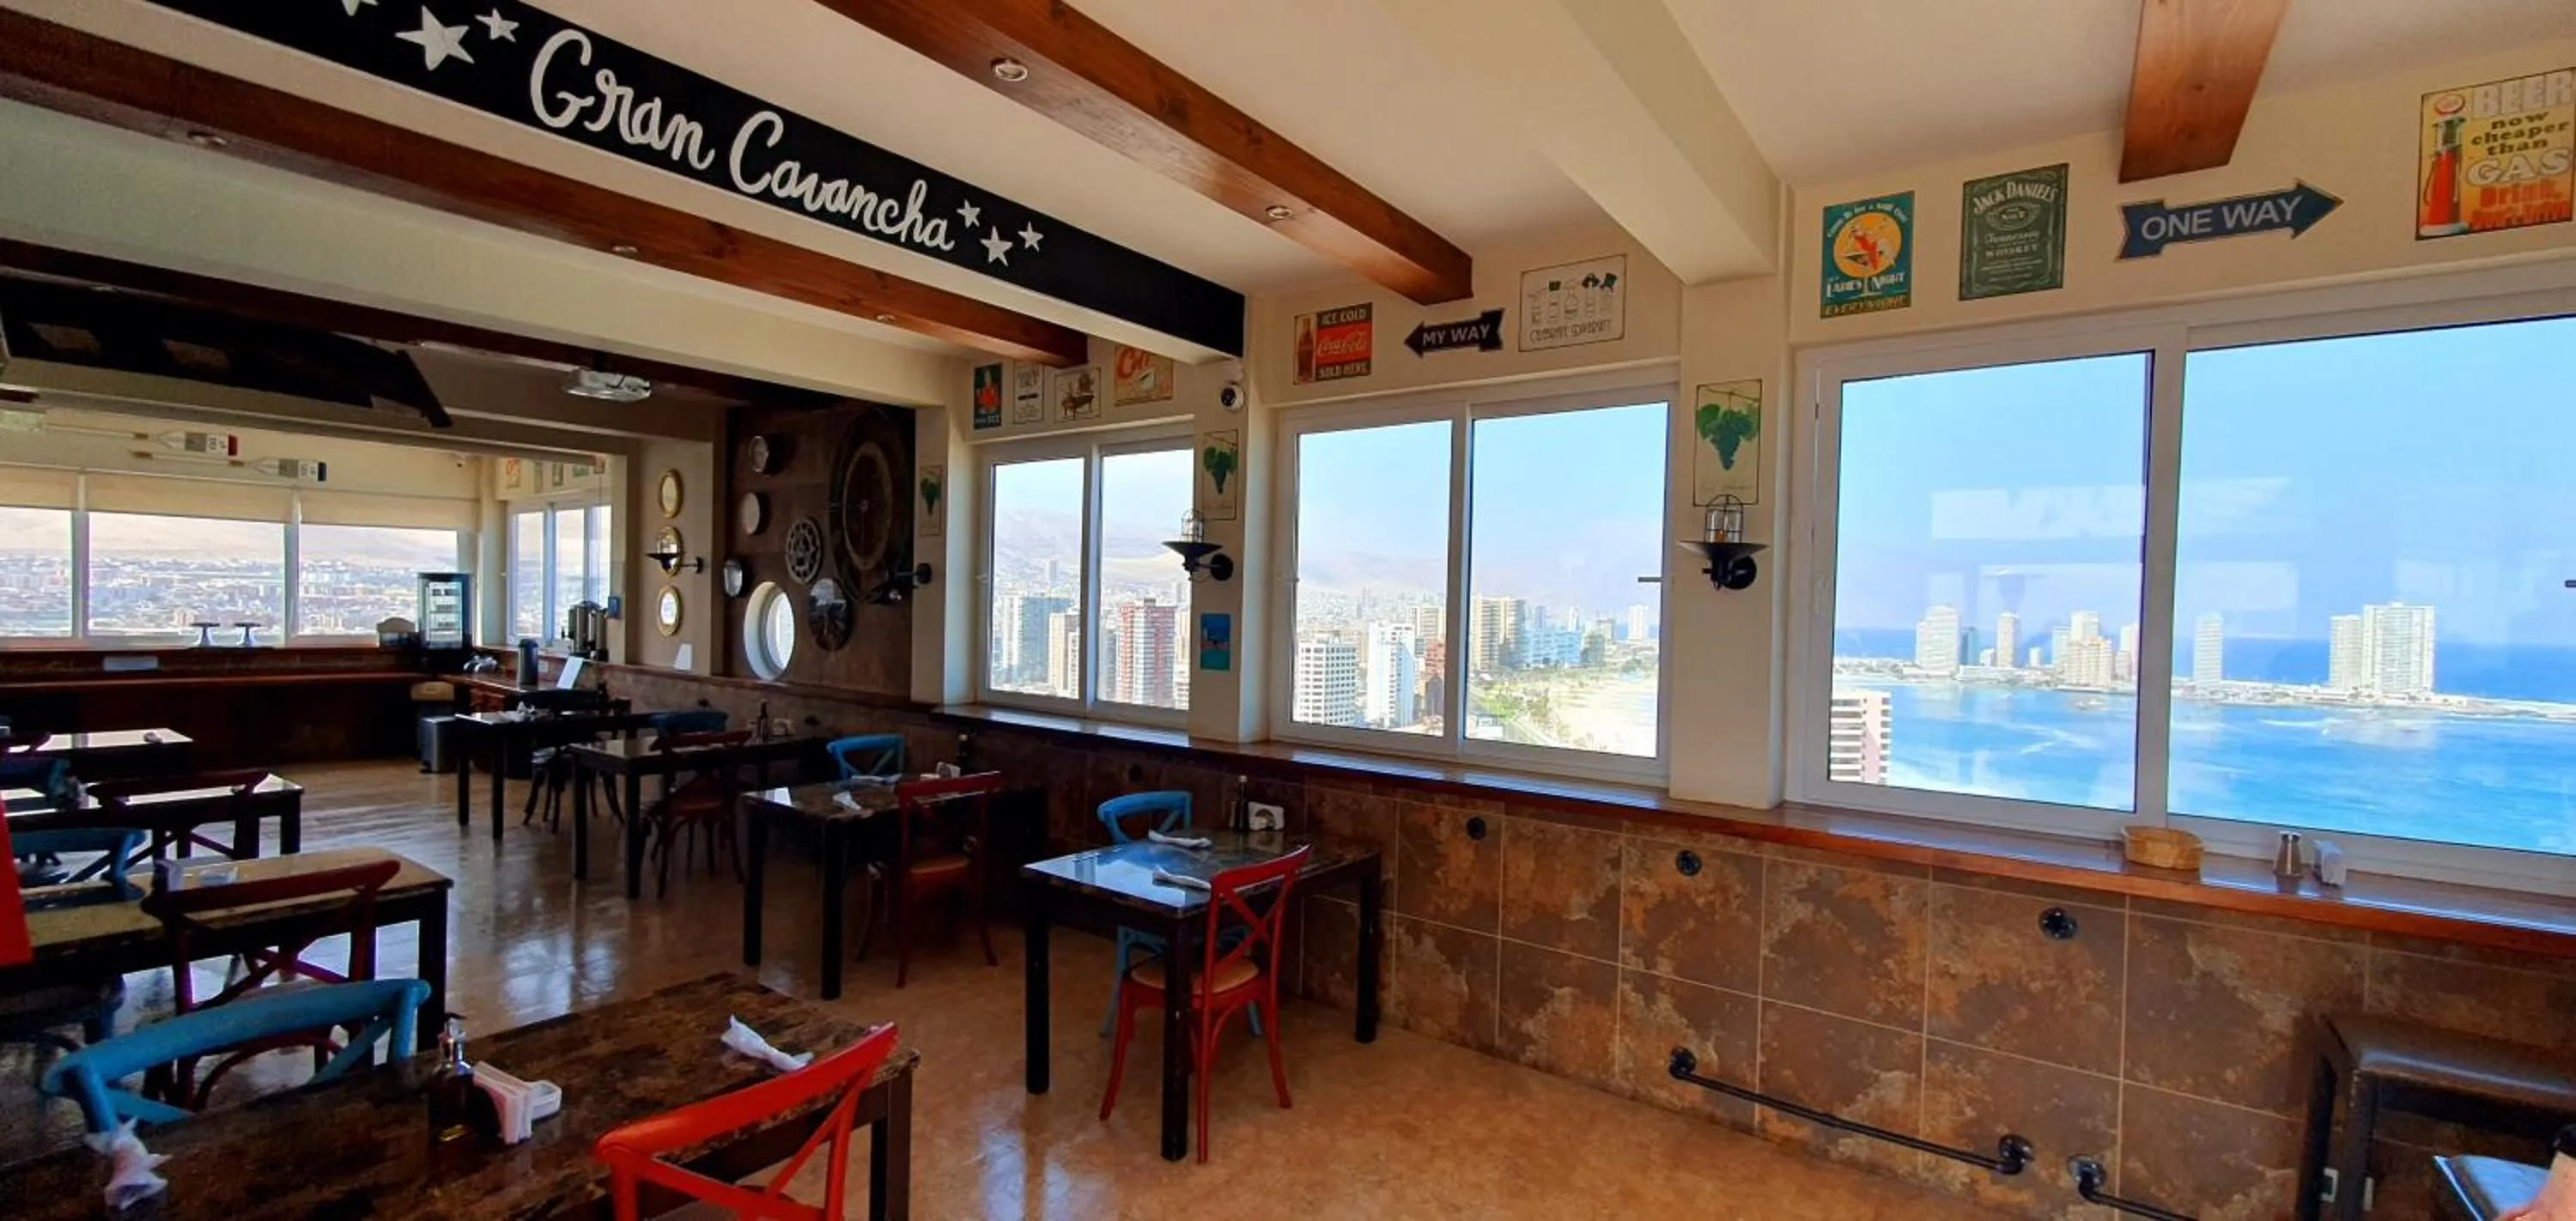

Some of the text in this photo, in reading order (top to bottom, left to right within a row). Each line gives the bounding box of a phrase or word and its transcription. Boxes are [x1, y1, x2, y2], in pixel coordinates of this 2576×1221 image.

[2472, 70, 2573, 119] BEER
[2491, 112, 2549, 130] now
[530, 28, 956, 252] Gran Cavancha
[2471, 121, 2570, 146] cheaper
[2487, 138, 2549, 155] than
[2465, 148, 2571, 187] GAS
[1973, 190, 2006, 214] JACK
[2141, 195, 2305, 240] ONE WAY
[1340, 307, 1366, 322] COLD
[1423, 324, 1491, 346] MY WAY
[1318, 361, 1367, 379] SOLD HERE
